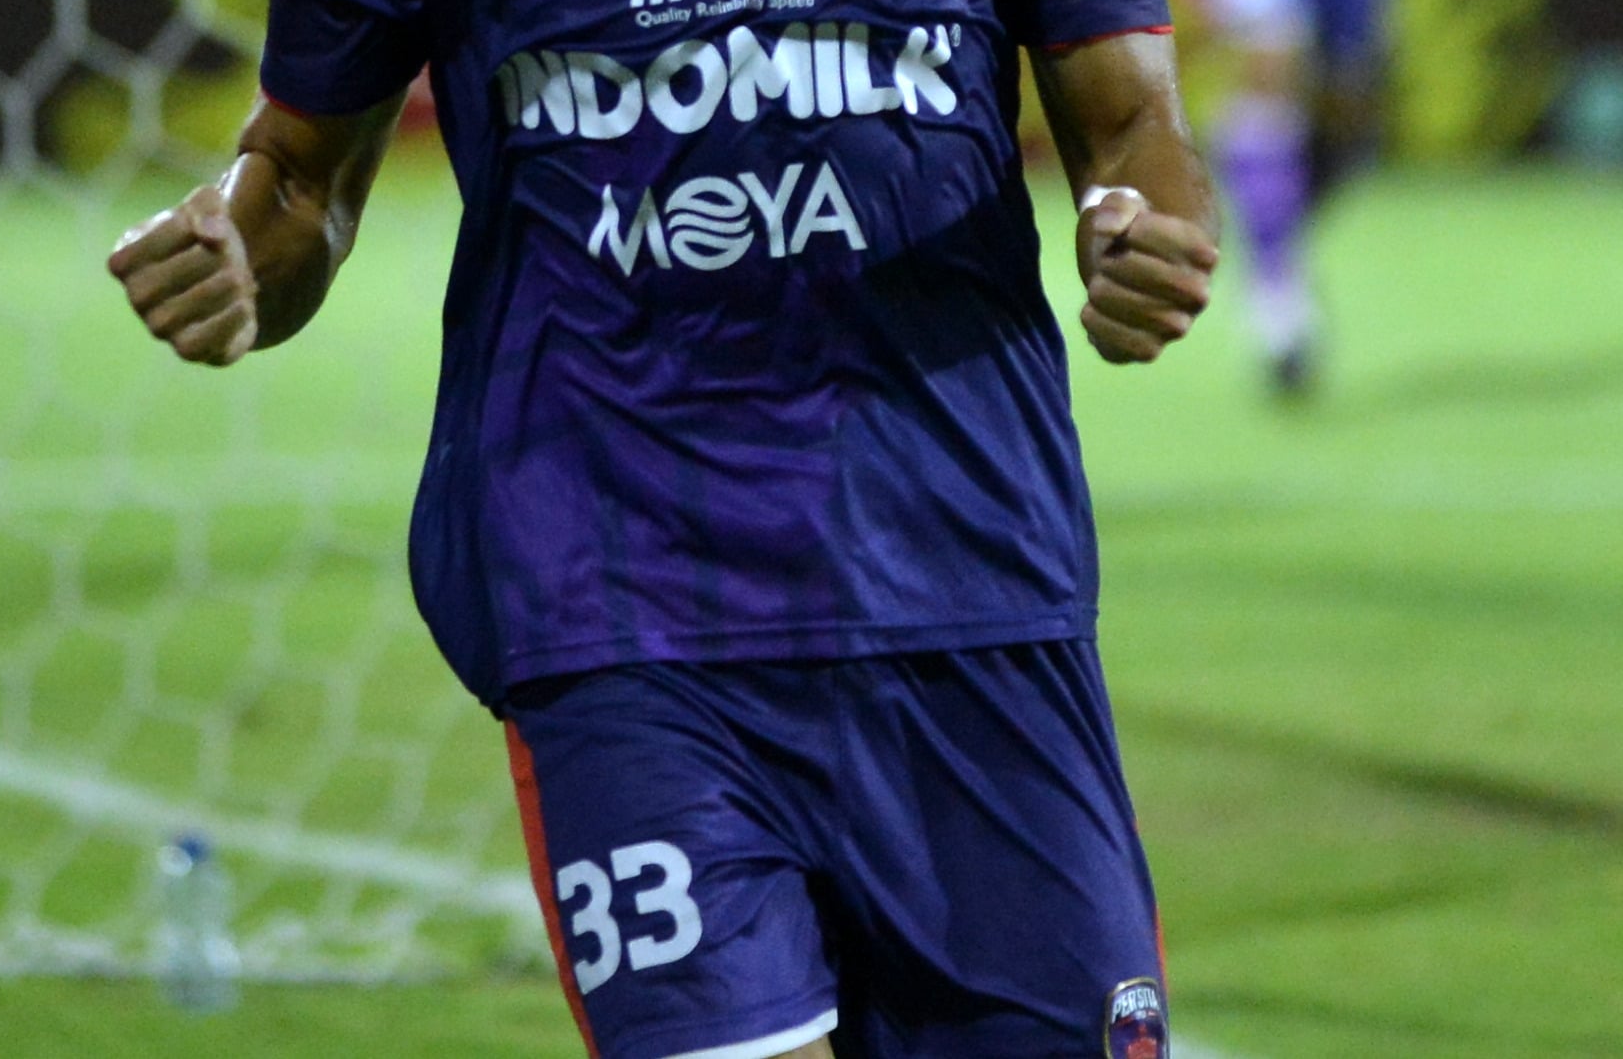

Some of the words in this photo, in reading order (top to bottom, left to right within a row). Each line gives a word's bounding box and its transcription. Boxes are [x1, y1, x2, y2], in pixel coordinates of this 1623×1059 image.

[635, 7, 692, 28] Quality
[494, 22, 957, 140] INDOMILK
[587, 160, 868, 278] MOYA
[556, 839, 703, 996] 33
